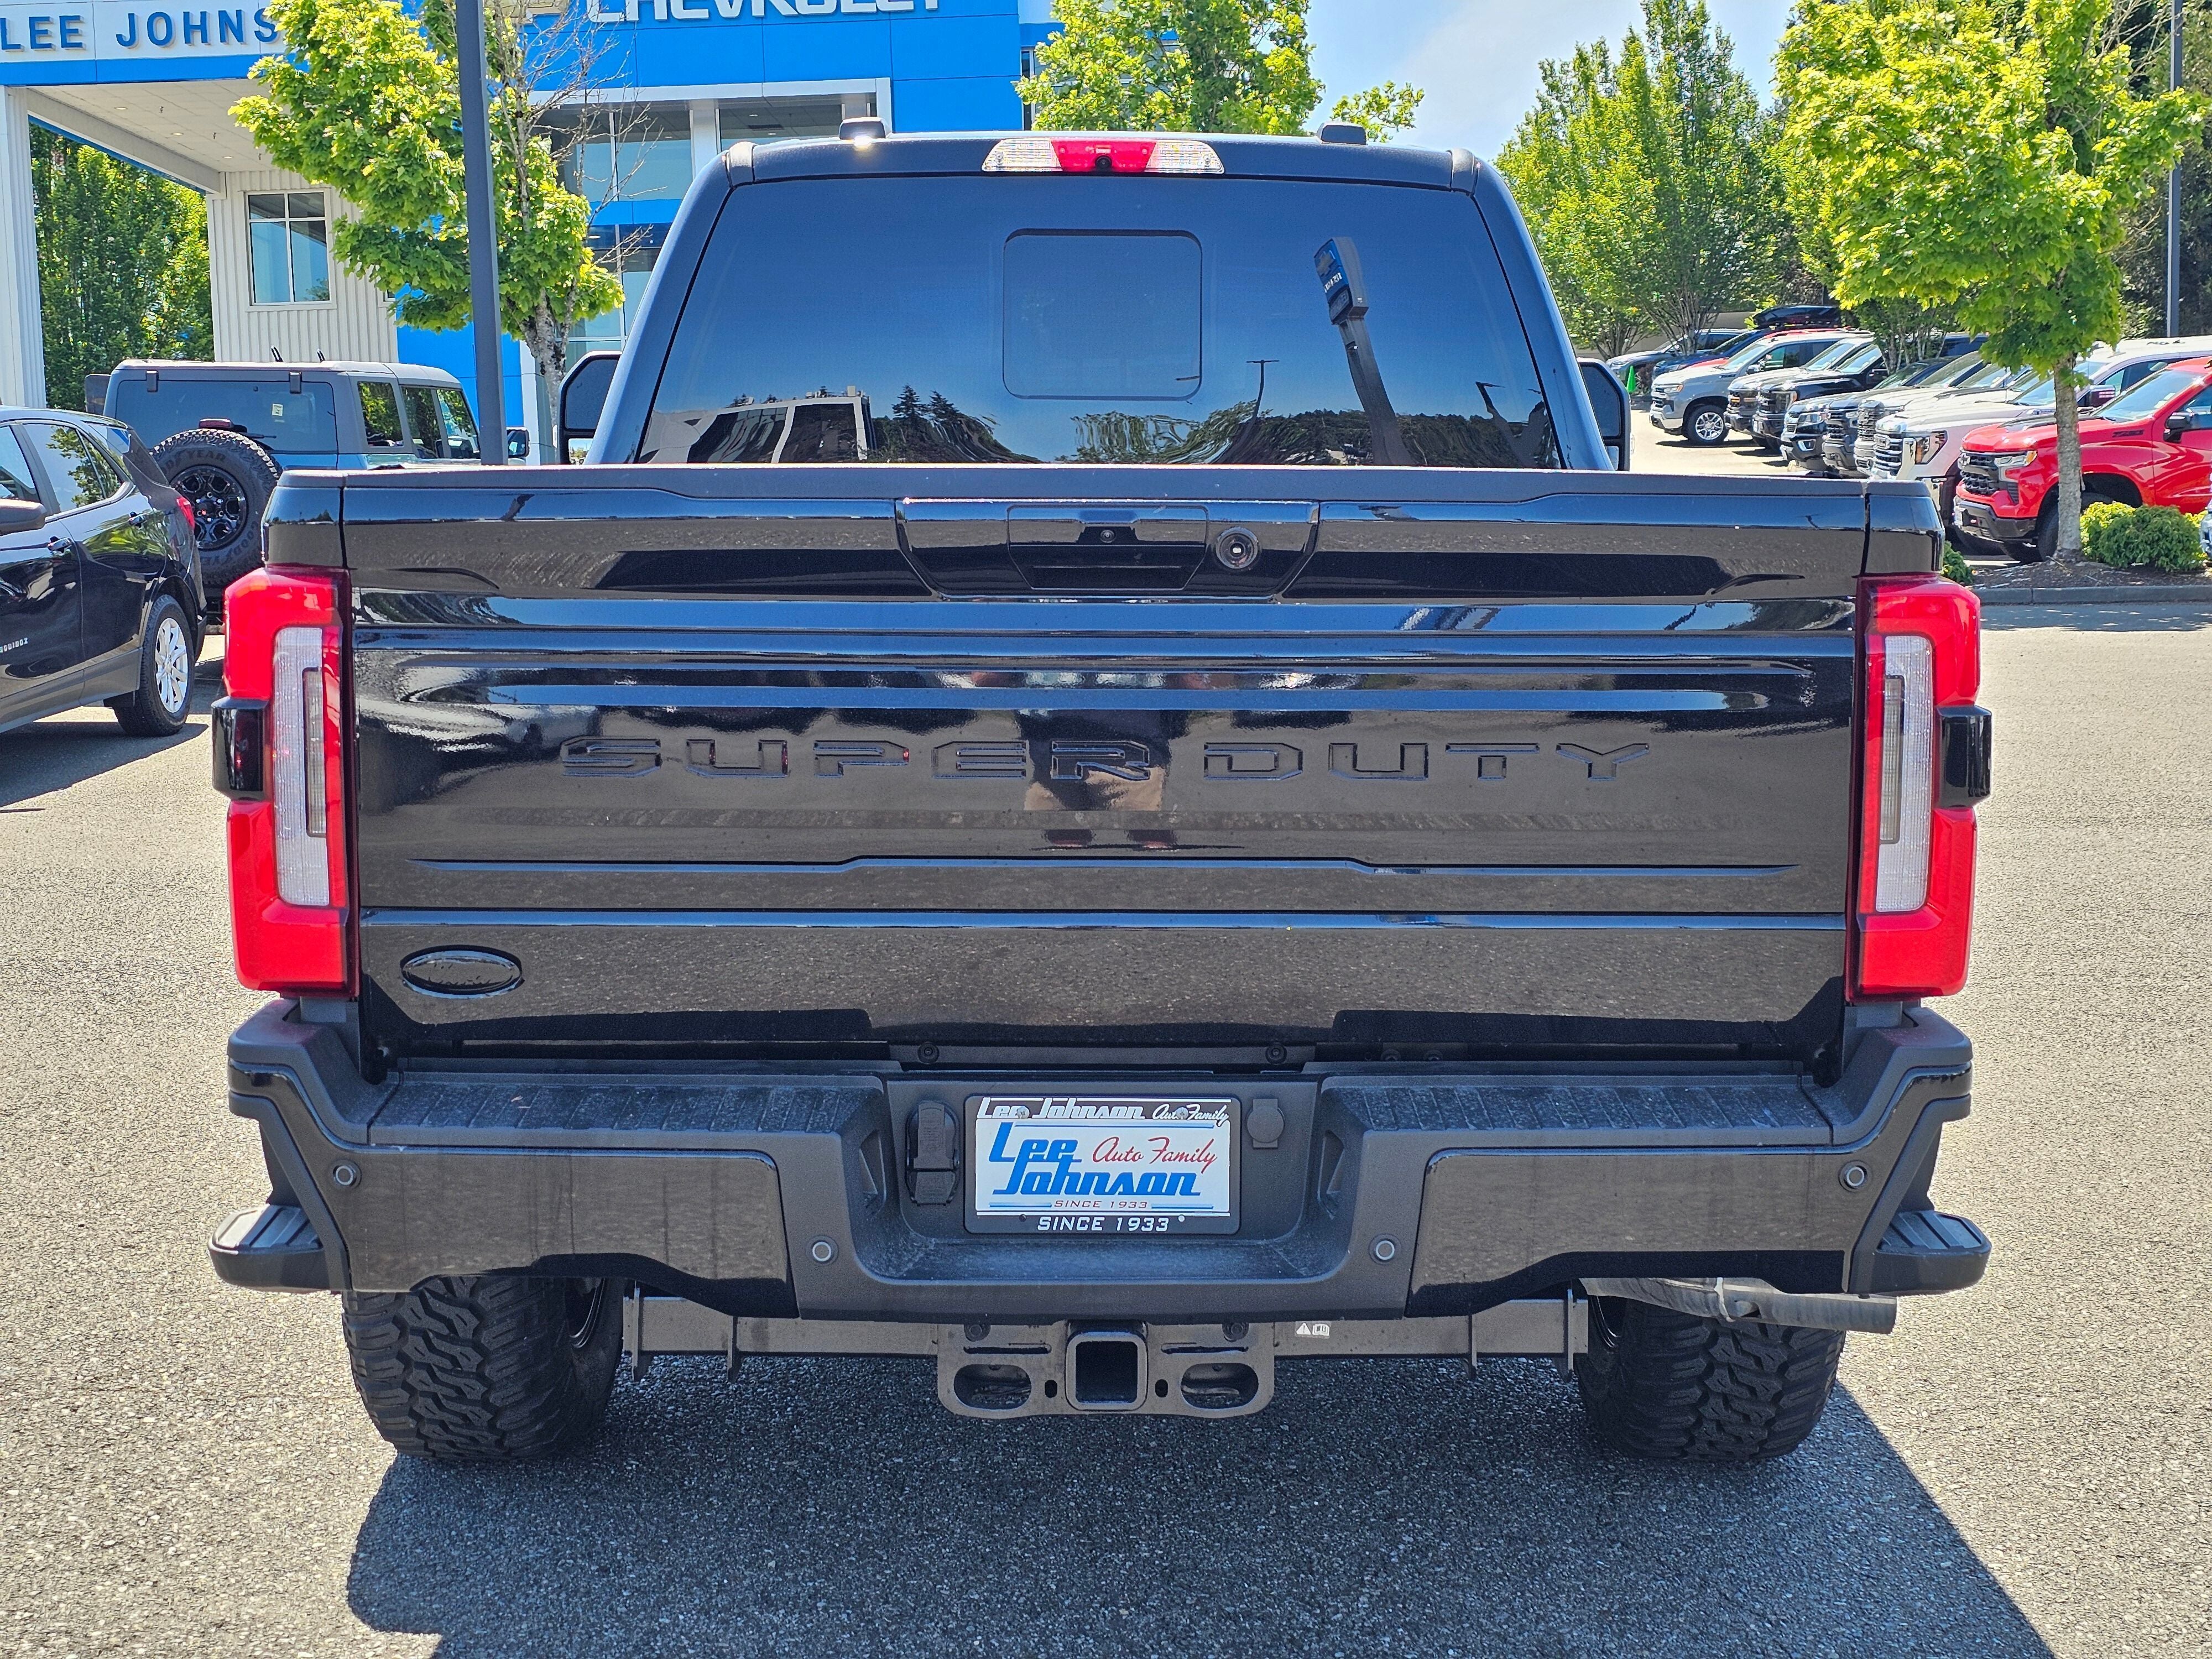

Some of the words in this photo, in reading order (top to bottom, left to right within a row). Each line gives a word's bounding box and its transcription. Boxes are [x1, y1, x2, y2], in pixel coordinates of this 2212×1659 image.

[0, 15, 84, 50] LEE
[116, 8, 278, 48] JOHNS
[560, 735, 1150, 781] SUPER
[1203, 742, 1650, 781] DUTY
[1032, 1097, 1146, 1119] Johnson
[1186, 1103, 1229, 1126] Family
[989, 1122, 1082, 1162] Lee
[1092, 1136, 1144, 1163] Auto
[1147, 1136, 1218, 1174] Family
[992, 1152, 1201, 1196] Johnson
[1037, 1216, 1105, 1231] SINCE
[1116, 1217, 1170, 1232] 1933
